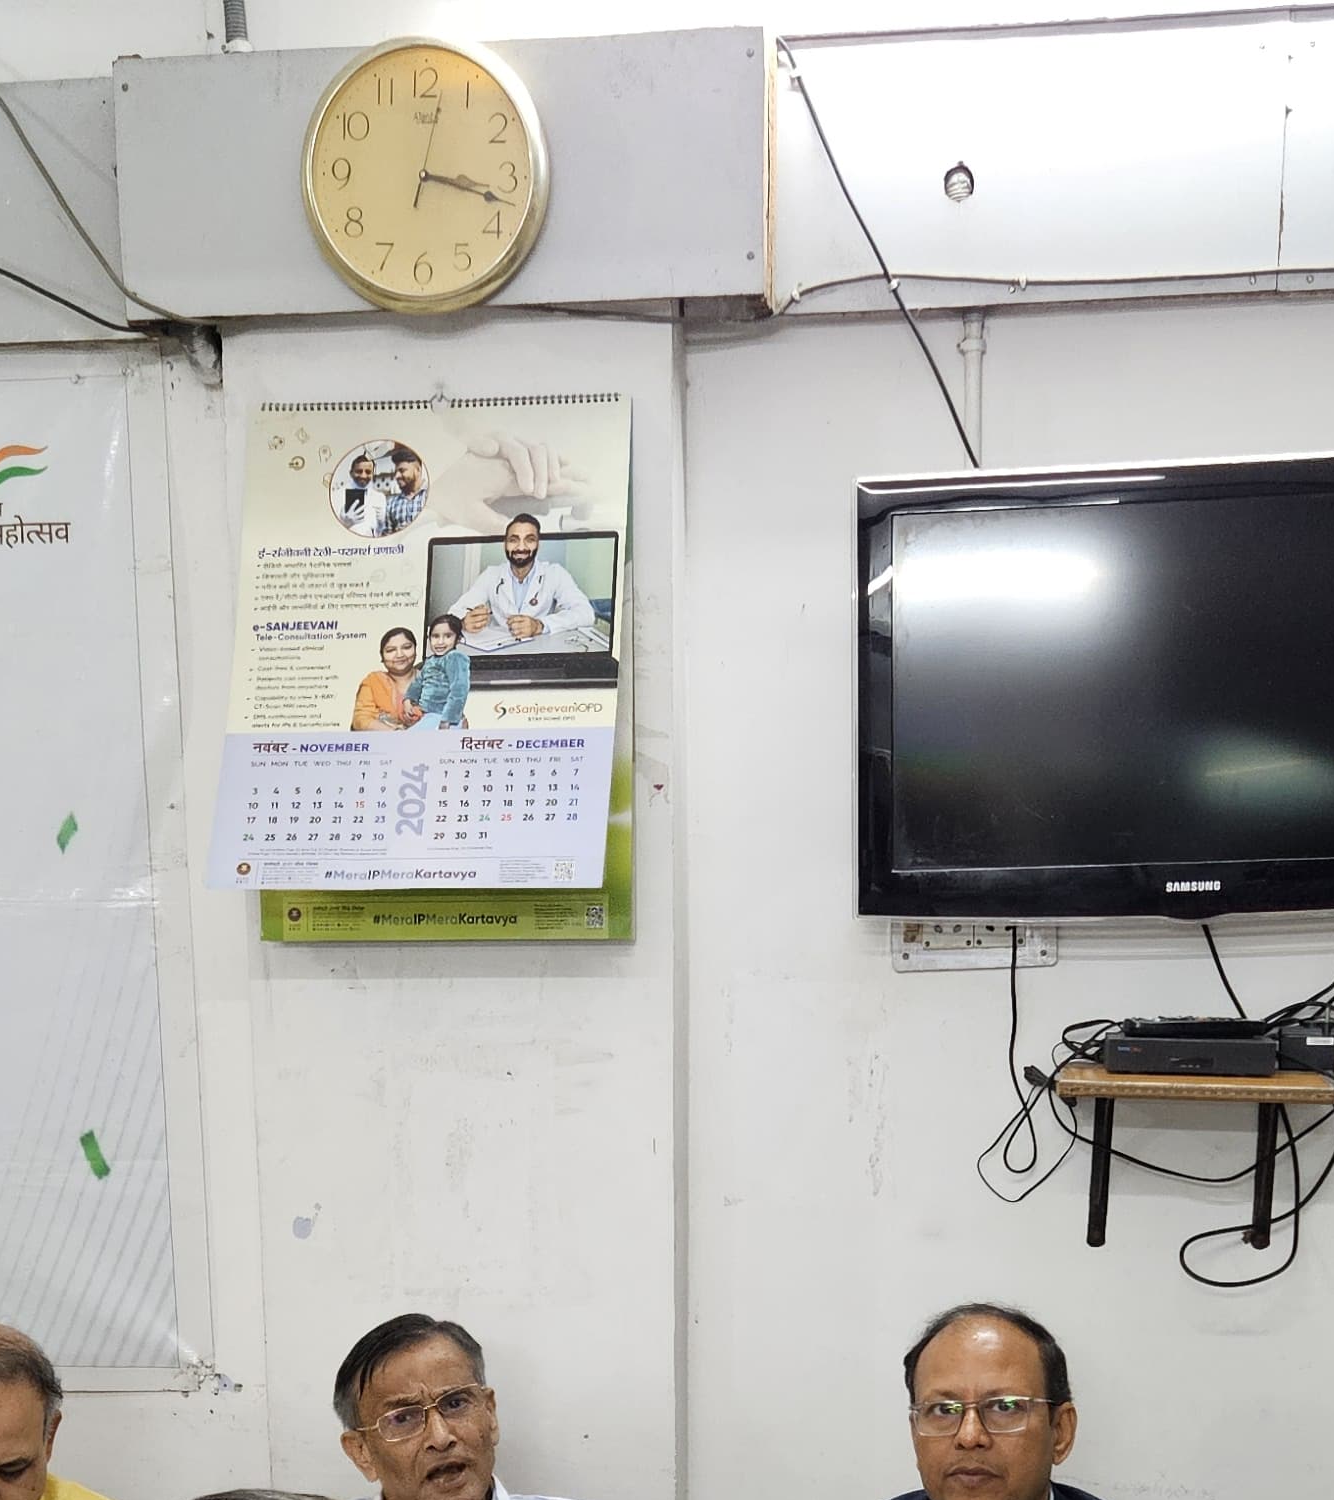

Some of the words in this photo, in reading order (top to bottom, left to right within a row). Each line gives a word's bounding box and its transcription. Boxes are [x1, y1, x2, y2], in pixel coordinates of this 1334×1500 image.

[378, 78, 393, 104] 11
[414, 68, 437, 97] 12
[466, 81, 469, 109] 1
[343, 111, 369, 141] 10
[489, 113, 507, 143] 2
[332, 158, 351, 190] 9
[497, 162, 517, 193] 3
[344, 207, 364, 238] 8
[482, 211, 502, 238] 4
[376, 243, 394, 271] 7
[414, 252, 432, 285] 6
[453, 244, 472, 271] 5
[252, 621, 339, 631] e-SANJEEVANI
[256, 633, 333, 641] Tele-Consultation
[336, 632, 367, 640] System
[252, 740, 289, 753] नवंबर
[300, 743, 369, 752] NOVEMBER
[461, 736, 504, 750] दिसंबर
[516, 739, 585, 748] DECEMBER
[395, 763, 431, 836] 2024
[308, 833, 318, 841] 27
[324, 868, 477, 882] #MeraIPMeraKartavya
[1166, 880, 1220, 893] SAMSUNG
[373, 912, 518, 927] #MeraIPMeraKartavya
